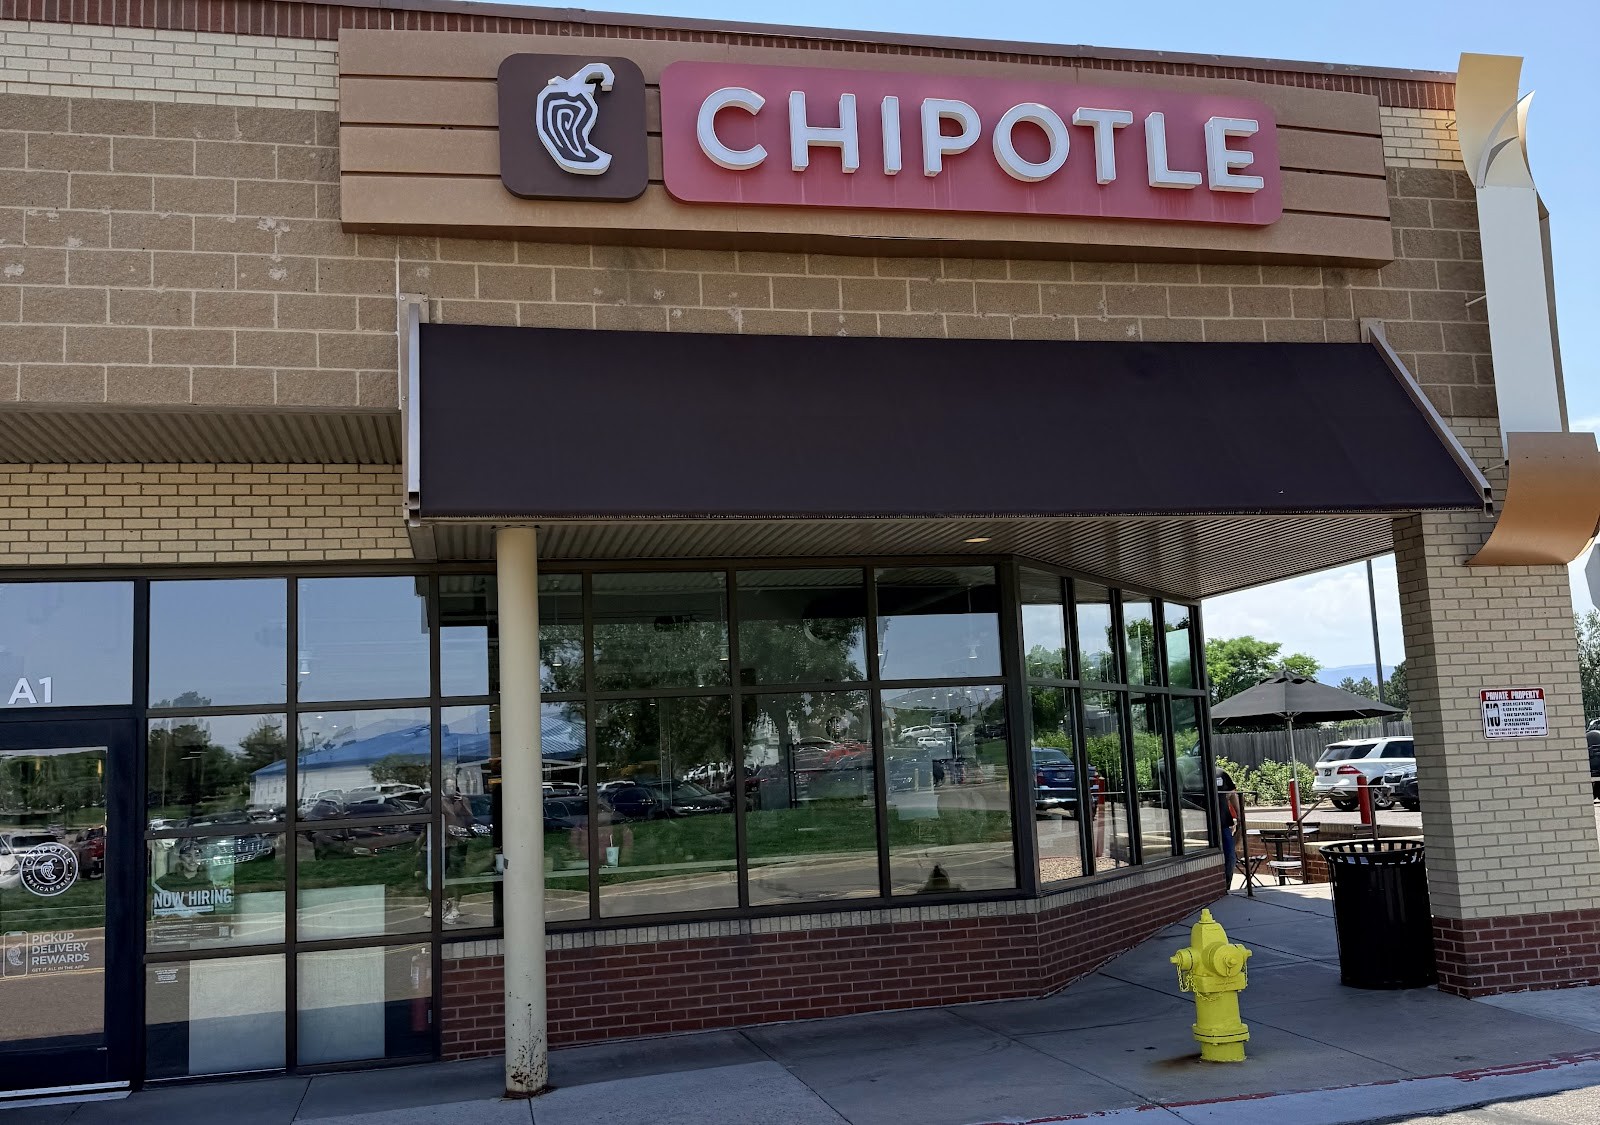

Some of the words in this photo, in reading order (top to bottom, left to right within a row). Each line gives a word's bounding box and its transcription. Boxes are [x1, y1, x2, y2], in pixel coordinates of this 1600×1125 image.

[696, 86, 1265, 193] CHIPOTLE
[7, 676, 52, 704] A1
[1485, 691, 1509, 700] PRIVATE
[1510, 690, 1540, 699] PROPERTY
[25, 845, 74, 866] CHIPOTLE
[26, 874, 55, 892] MEXICAN
[55, 873, 73, 889] GRILL
[153, 891, 185, 908] NOW
[188, 888, 233, 906] HIRING
[32, 932, 75, 944] PICKUP
[31, 942, 89, 955] DELIVERY
[31, 952, 90, 965] REWARDS
